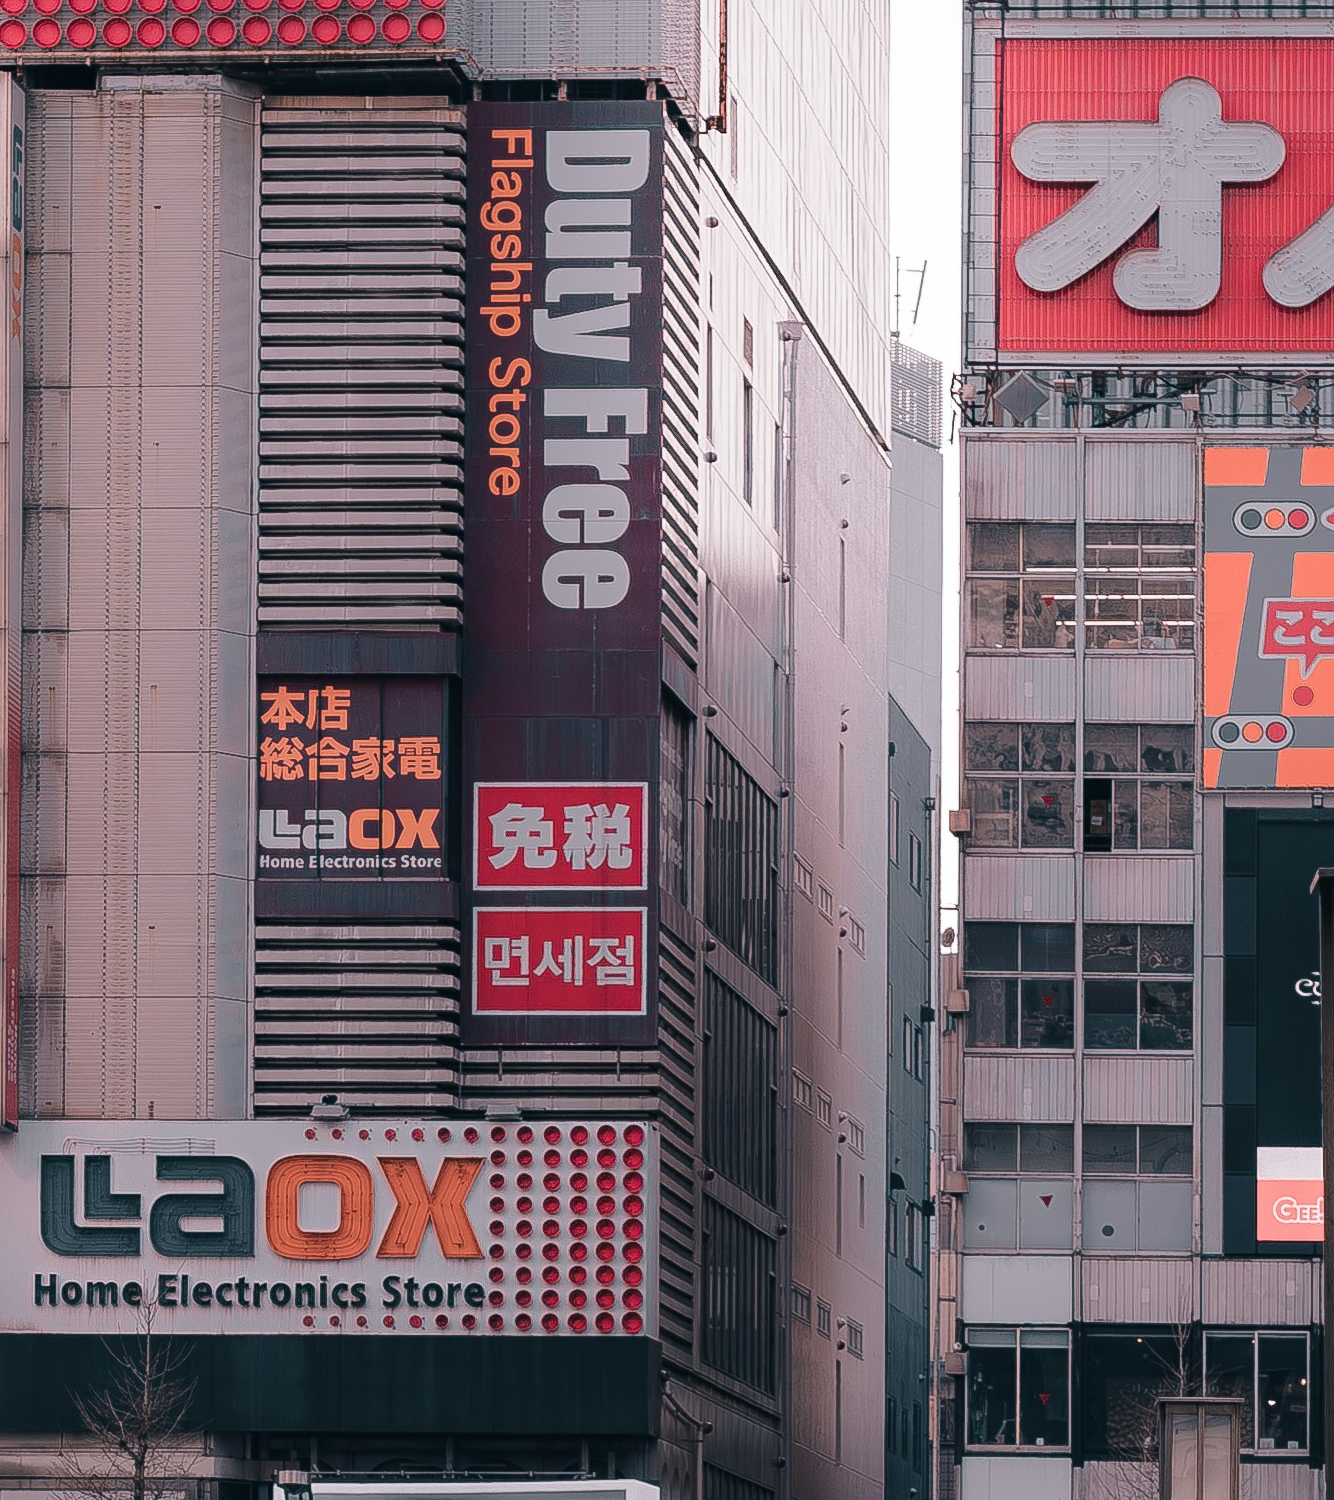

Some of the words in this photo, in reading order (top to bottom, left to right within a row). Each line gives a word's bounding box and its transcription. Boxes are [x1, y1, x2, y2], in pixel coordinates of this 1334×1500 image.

[478, 129, 533, 338] Flagship
[533, 129, 652, 362] Duty
[489, 355, 533, 498] Store
[540, 386, 649, 611] Free
[260, 685, 351, 731] 本店
[258, 735, 442, 783] 総合家電
[259, 852, 306, 870] Home
[308, 852, 395, 870] Electronics
[399, 853, 443, 870] Store
[488, 802, 635, 871] 免税
[483, 935, 638, 987] 면세점
[33, 1273, 143, 1308] Home
[158, 1273, 366, 1309] Electronics
[382, 1275, 486, 1309] Store
